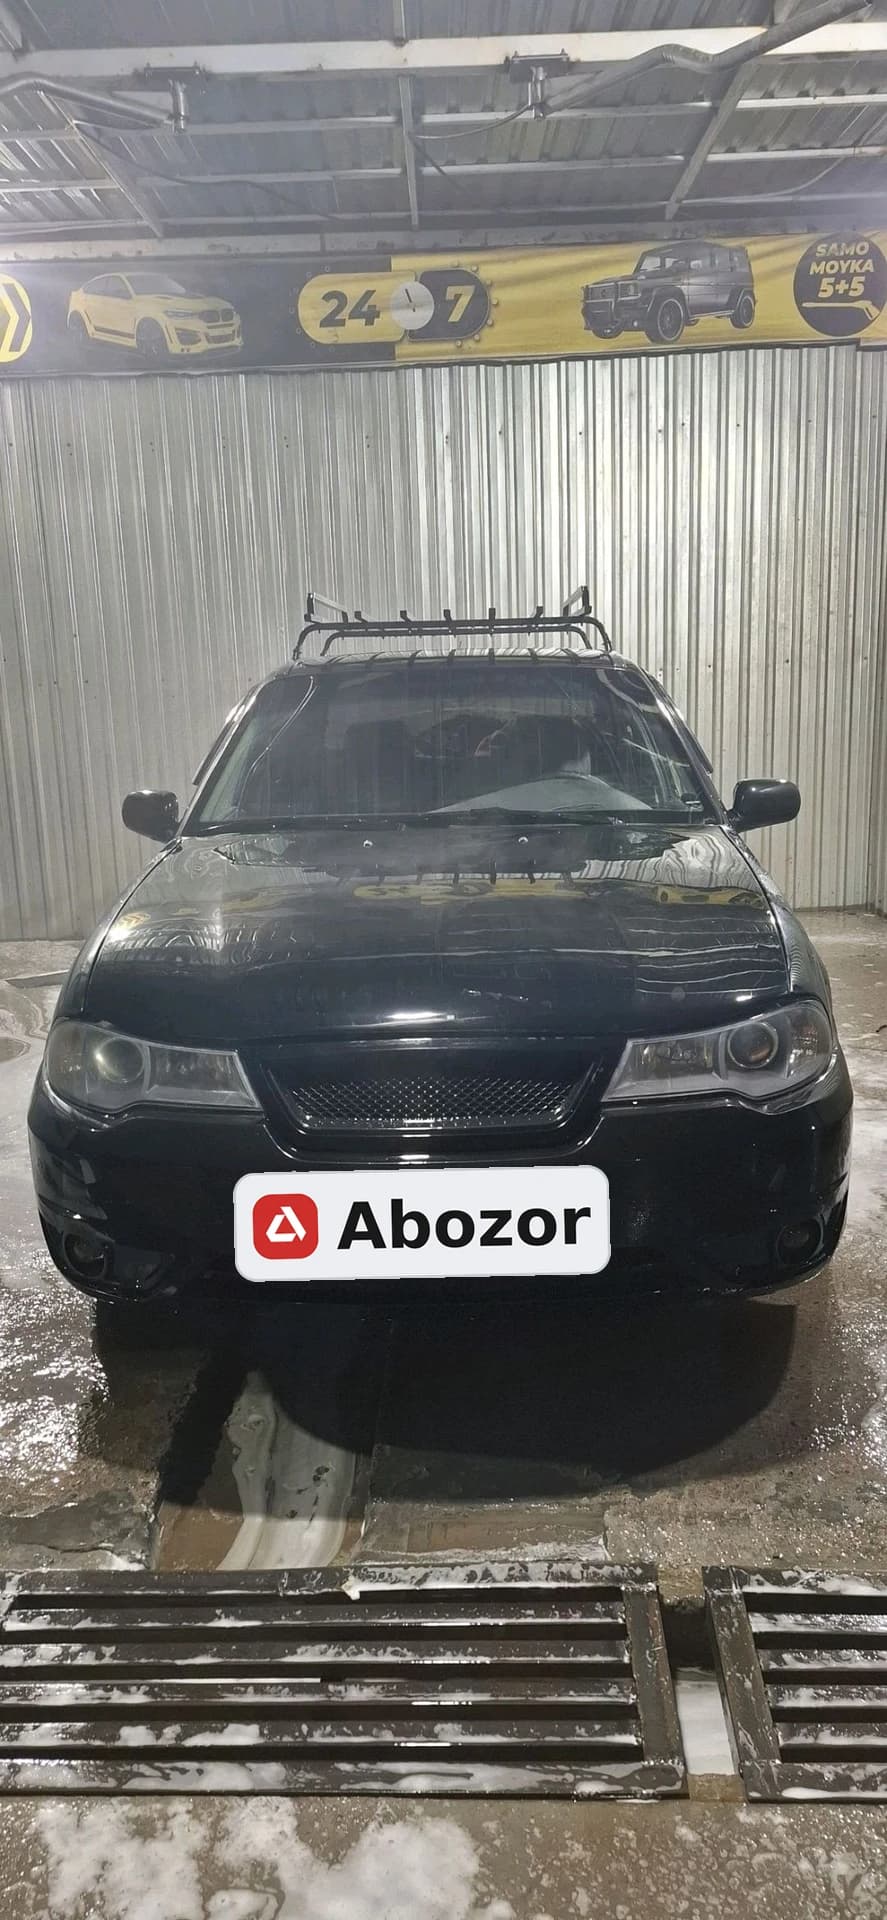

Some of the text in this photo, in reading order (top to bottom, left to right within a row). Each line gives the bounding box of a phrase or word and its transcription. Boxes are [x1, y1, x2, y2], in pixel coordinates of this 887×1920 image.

[815, 242, 869, 256] SAMO
[810, 260, 874, 275] MOYKA
[818, 276, 866, 298] 5+5
[319, 289, 380, 328] 24
